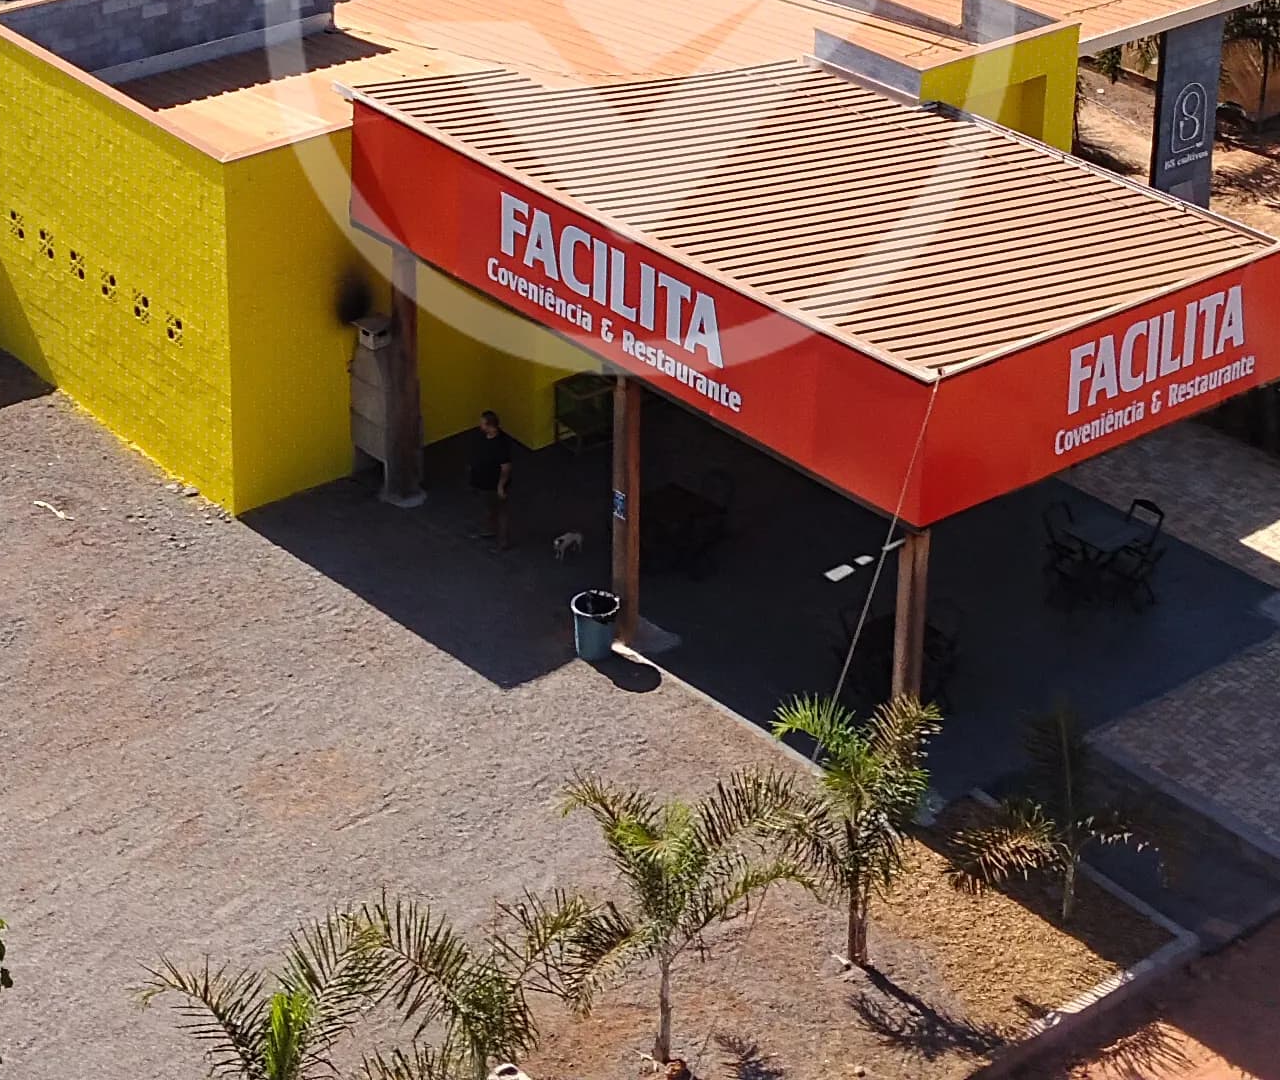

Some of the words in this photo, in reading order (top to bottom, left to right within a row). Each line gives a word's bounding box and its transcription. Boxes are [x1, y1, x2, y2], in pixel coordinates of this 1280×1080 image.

[487, 257, 593, 332] Coveniência
[600, 317, 614, 343] &
[622, 329, 742, 413] Restaurante
[500, 191, 724, 368] FACILITA
[1067, 285, 1245, 416] FACILITA
[1054, 401, 1144, 455] Coveniência
[1151, 390, 1161, 414] &
[1168, 355, 1255, 407] Restaurante
